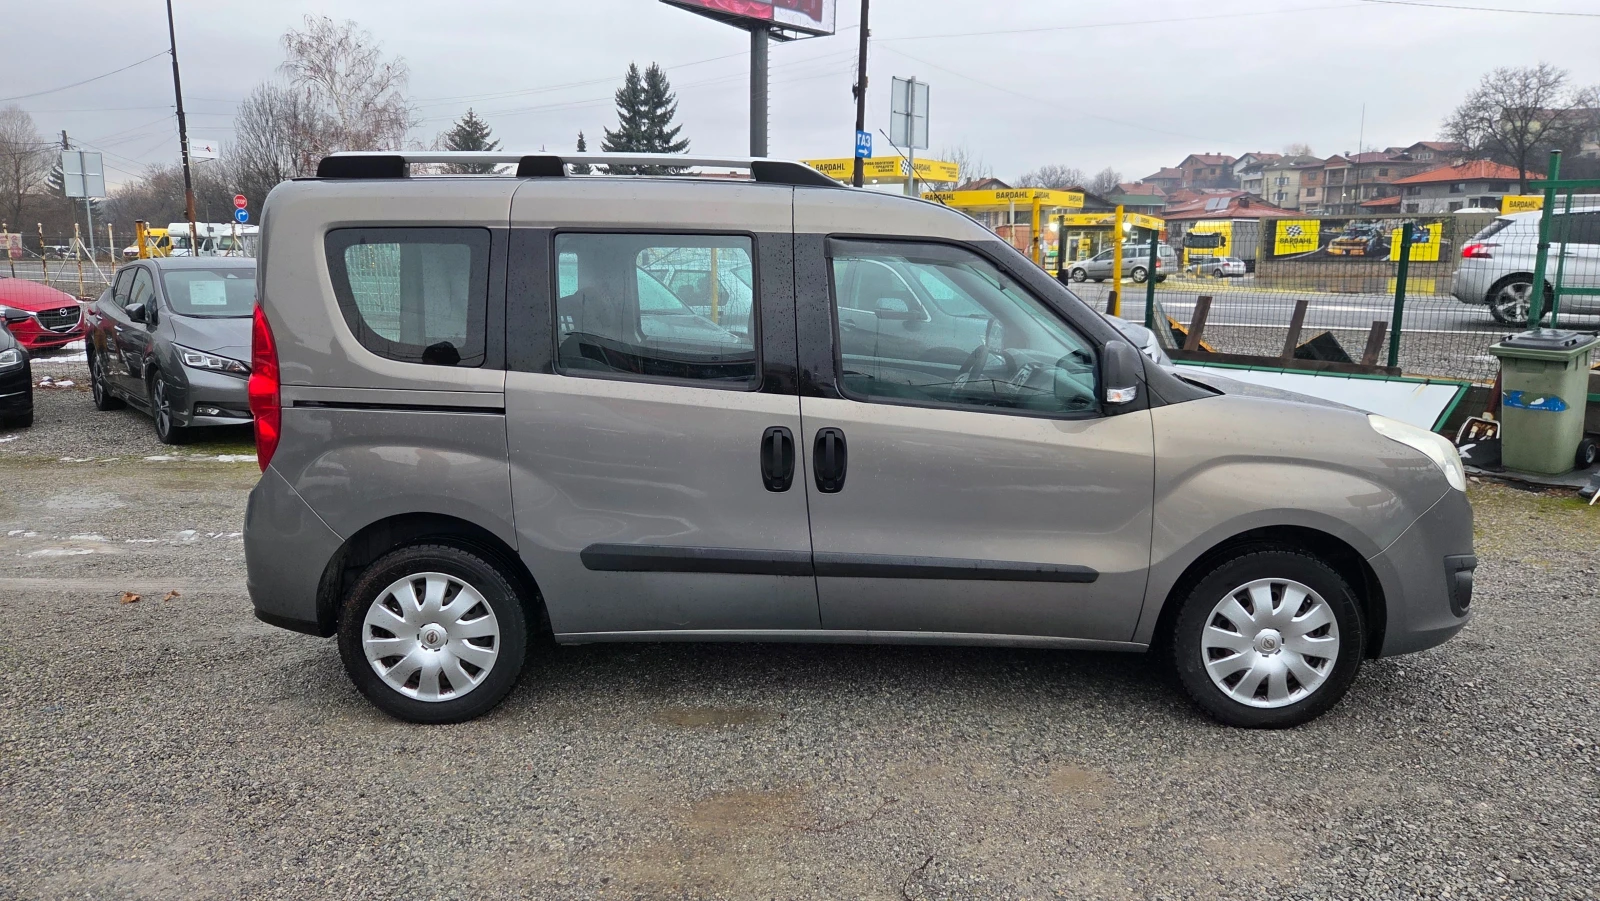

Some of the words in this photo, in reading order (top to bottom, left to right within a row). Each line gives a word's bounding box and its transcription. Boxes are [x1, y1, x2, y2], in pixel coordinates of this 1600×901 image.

[857, 133, 871, 147] ГАЗ
[815, 163, 846, 174] BARDAHL
[995, 191, 1028, 201] BARDAHL
[1509, 200, 1535, 210] BARDAHL
[1280, 238, 1312, 248] BARDAHL
